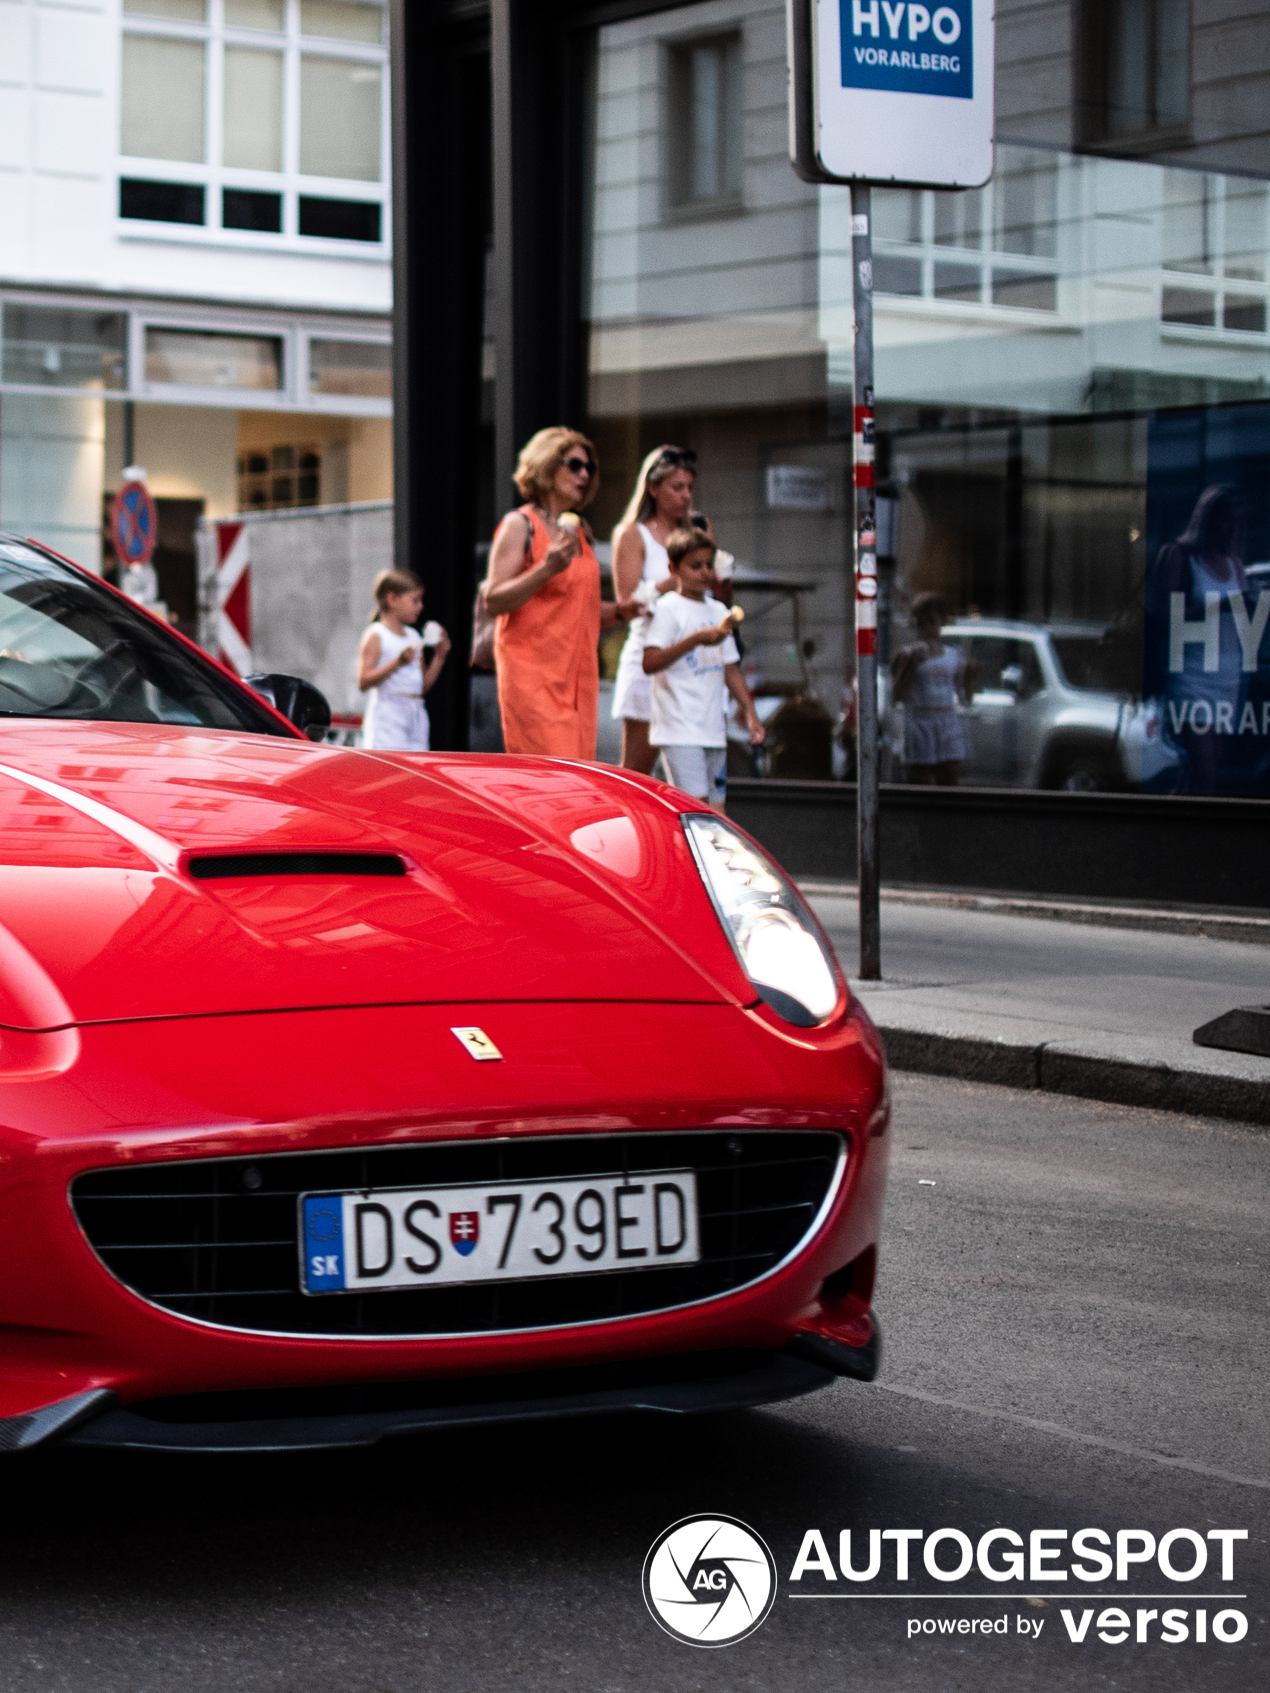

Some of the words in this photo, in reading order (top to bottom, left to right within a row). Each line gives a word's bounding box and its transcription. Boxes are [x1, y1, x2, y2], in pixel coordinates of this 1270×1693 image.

[852, 0, 961, 44] HYPO
[854, 46, 961, 73] VORARLBERG
[1169, 591, 1270, 672] HY
[354, 1199, 442, 1278] DS
[486, 1182, 687, 1269] 739ED
[311, 1255, 339, 1277] SK
